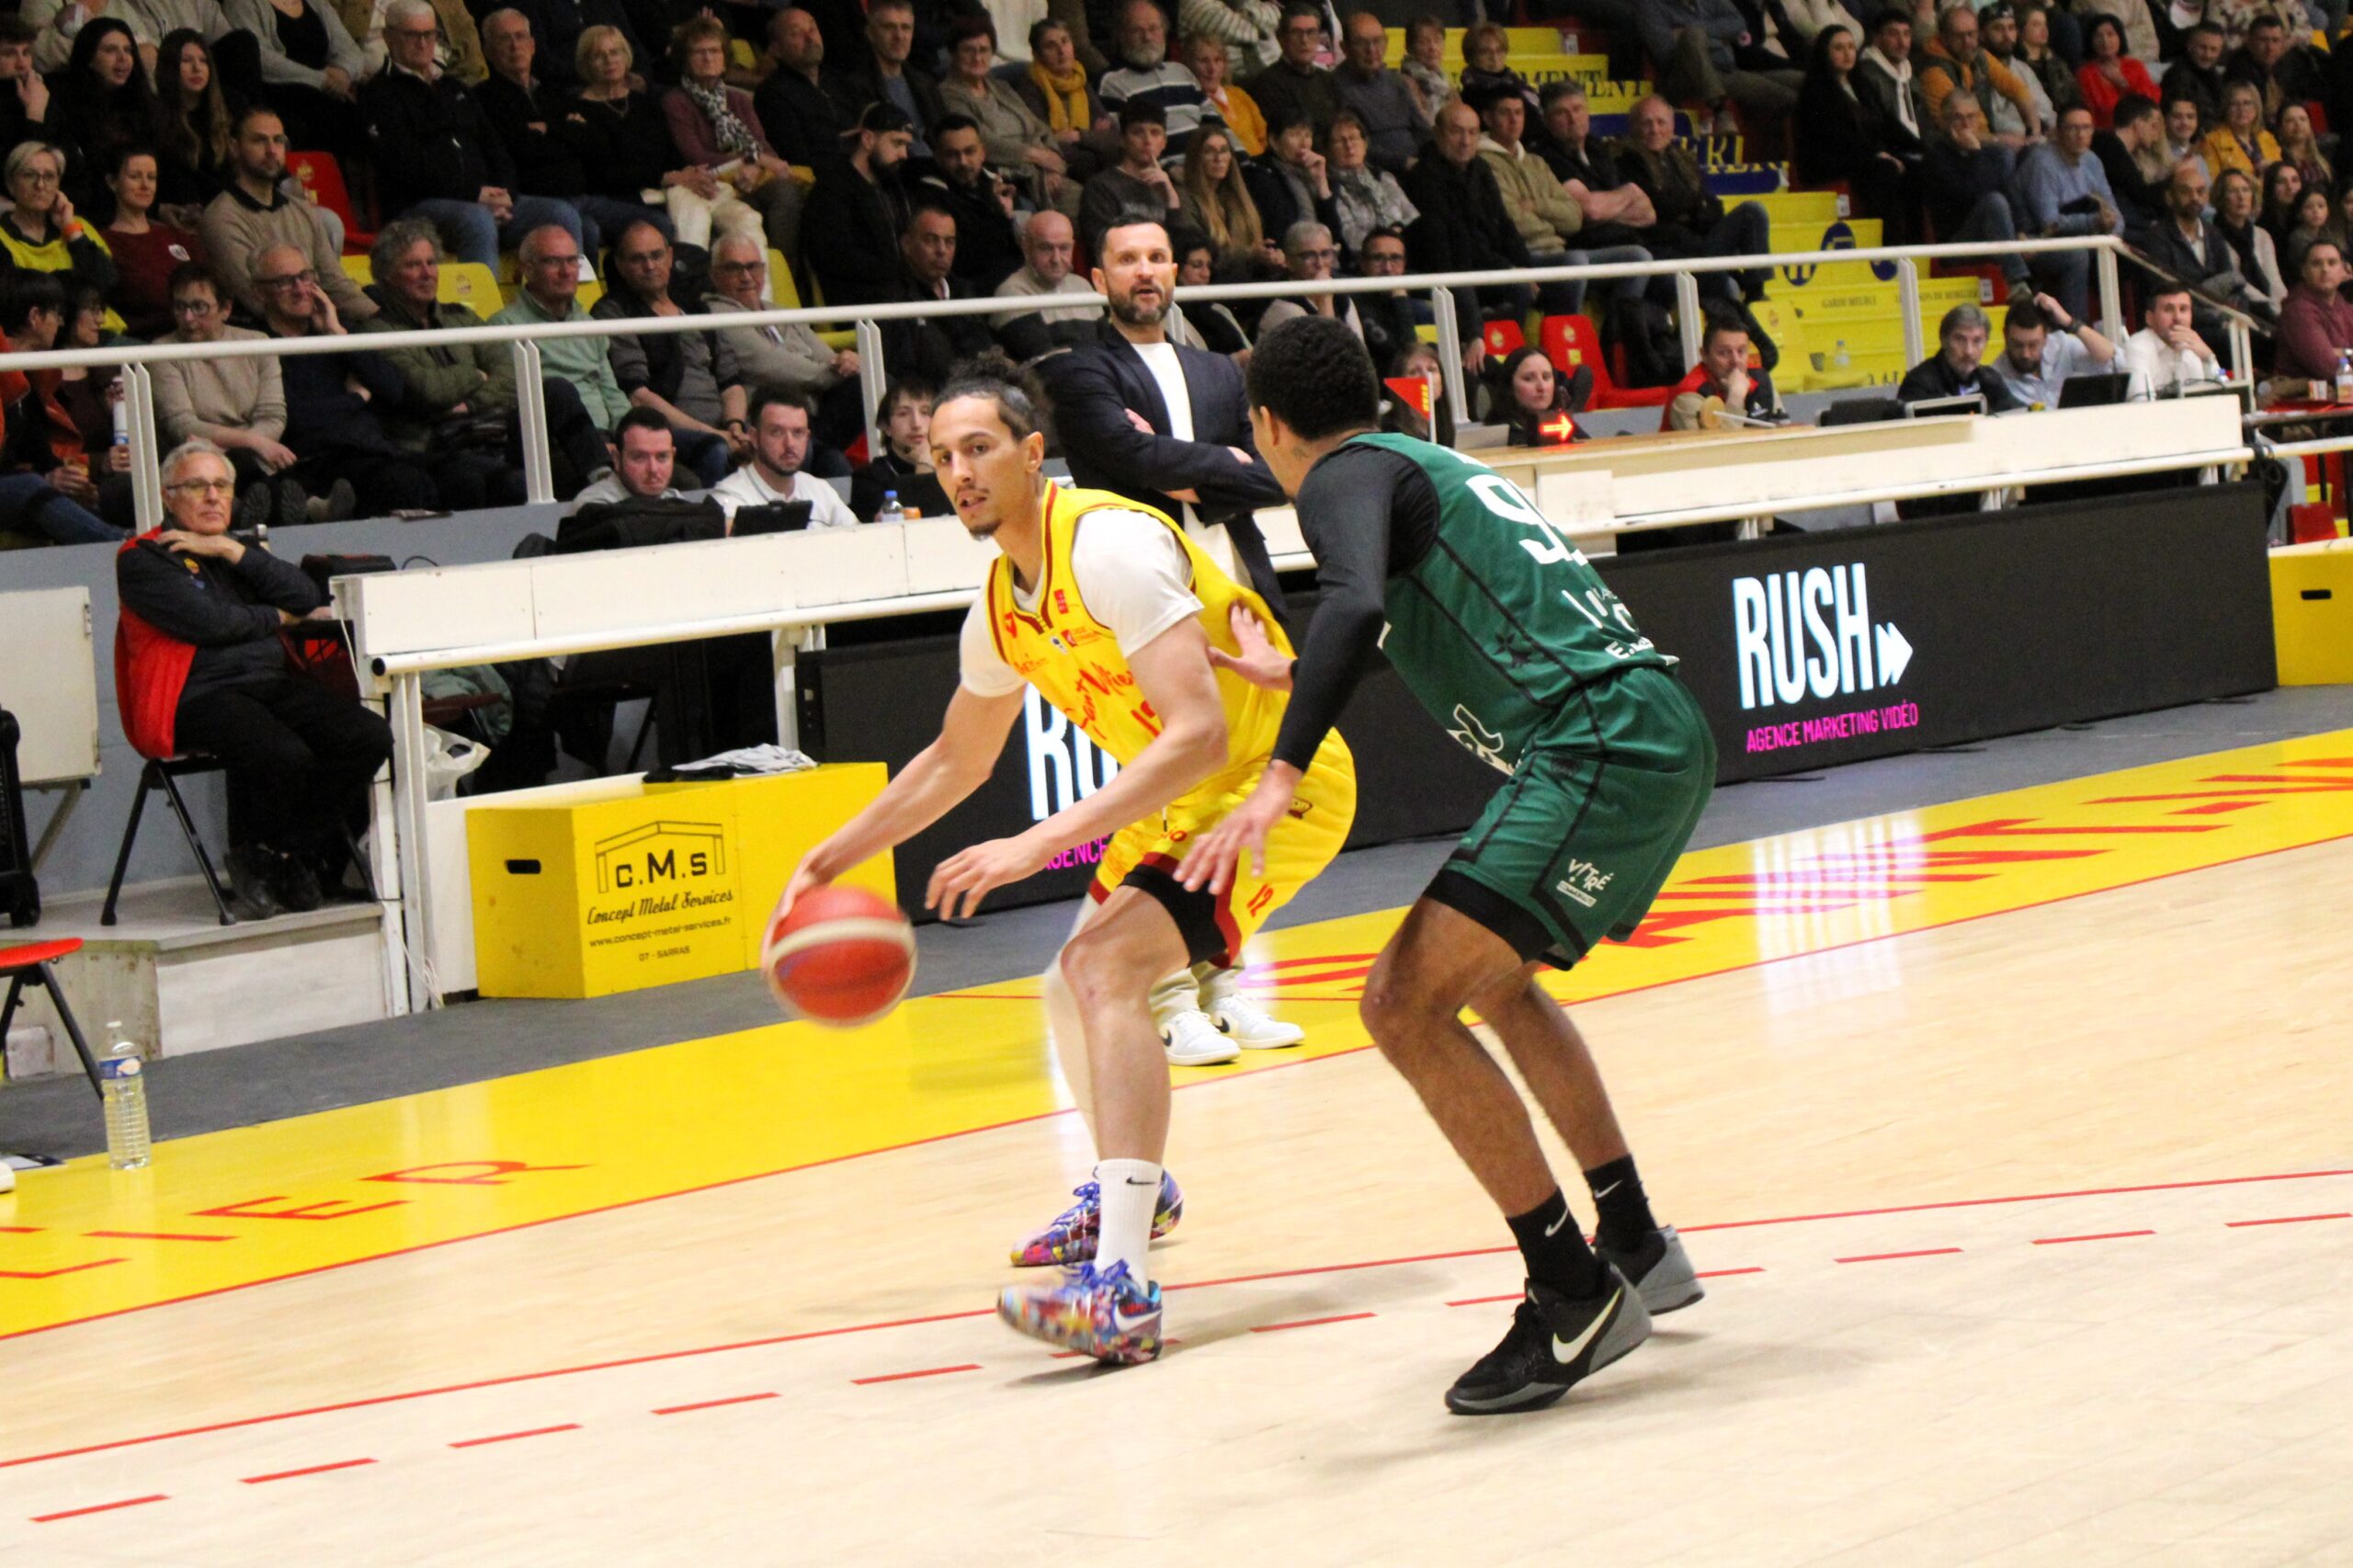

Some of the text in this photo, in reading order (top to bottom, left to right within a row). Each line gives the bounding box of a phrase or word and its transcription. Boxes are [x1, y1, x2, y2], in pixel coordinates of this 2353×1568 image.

[1733, 562, 1874, 710] RUSH
[1747, 699, 1919, 753] AGENCE MARKETING VIDÉO
[616, 848, 707, 889] C.M.S
[586, 889, 733, 925] Concept Metal Services
[588, 915, 732, 948] www.concept-metal-services.fr
[656, 946, 691, 960] SARRAS
